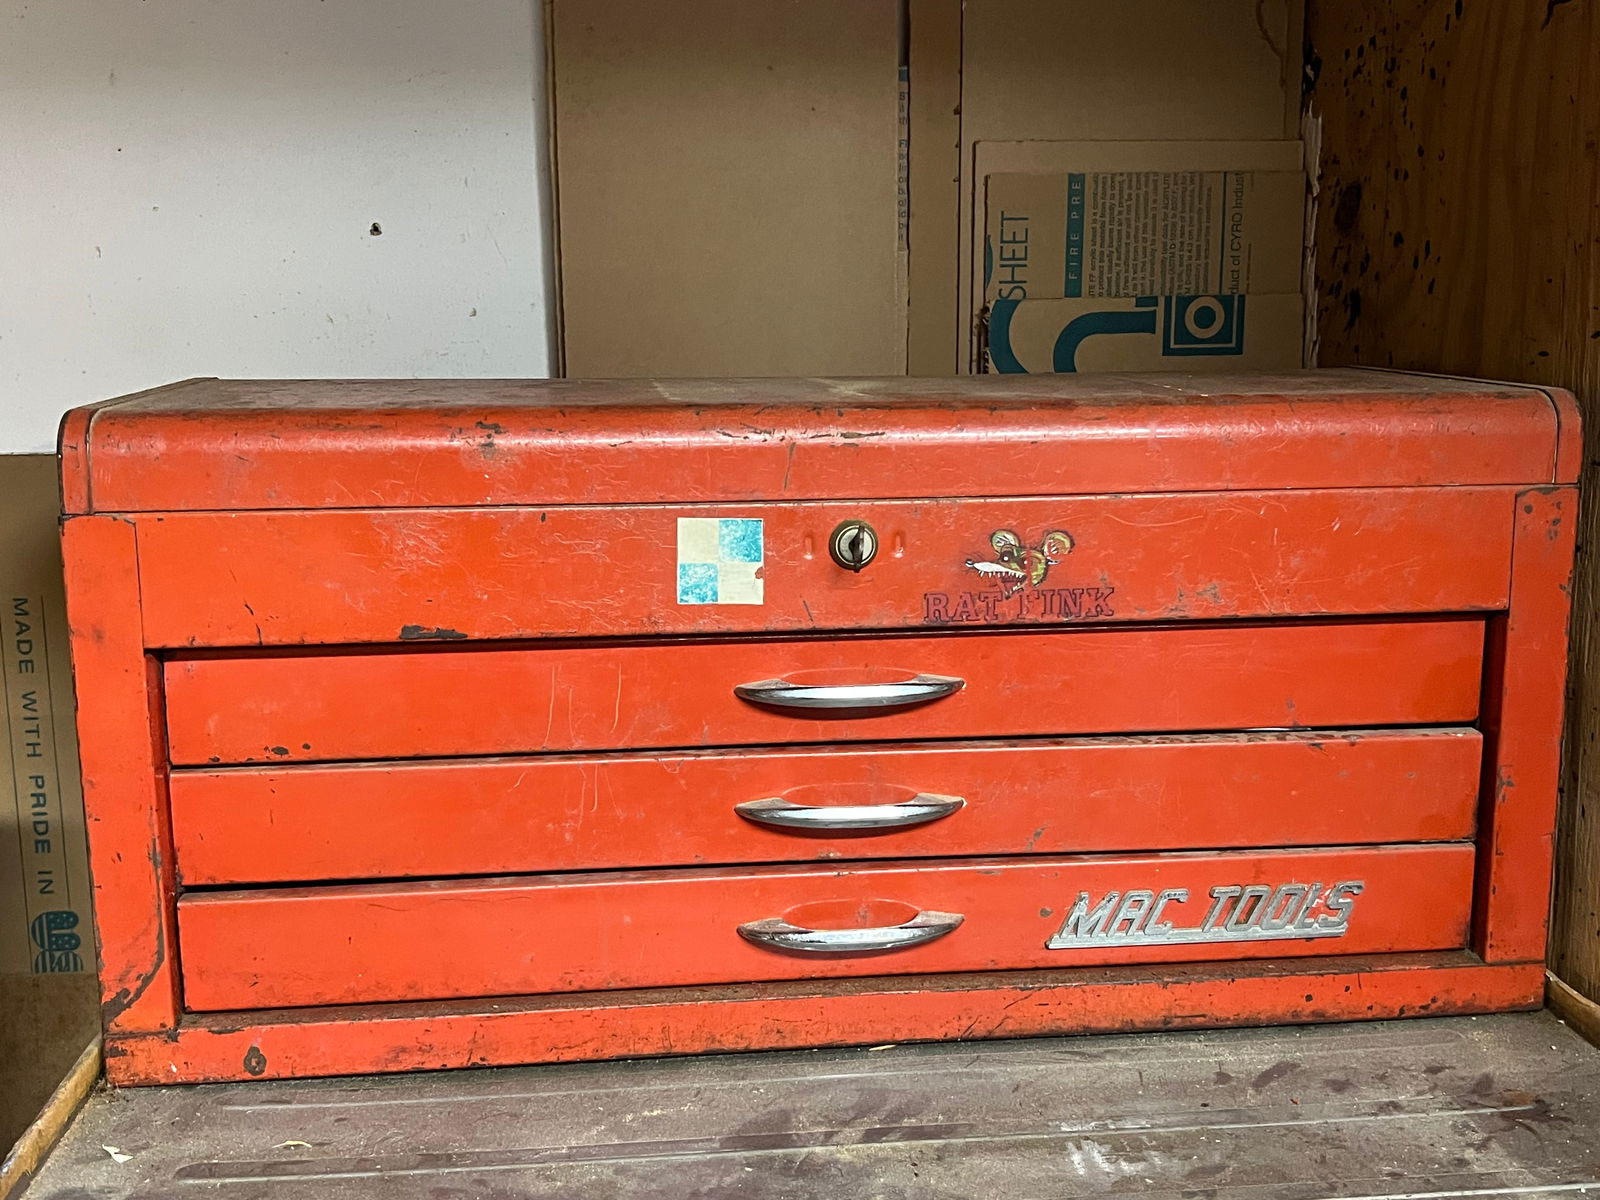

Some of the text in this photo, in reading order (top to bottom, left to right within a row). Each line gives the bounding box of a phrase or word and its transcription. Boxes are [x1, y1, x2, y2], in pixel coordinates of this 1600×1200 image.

[998, 211, 1028, 300] SHEET
[1069, 183, 1081, 279] FIRE PRE
[1230, 255, 1240, 265] of
[1231, 213, 1242, 251] CYRO
[1228, 269, 1240, 294] duct
[924, 587, 1115, 623] RAT FINK
[12, 597, 35, 674] MADE
[21, 691, 44, 758] WITH
[28, 775, 52, 855] PRIDE
[37, 870, 55, 895] IN
[1059, 881, 1365, 940] MAC TOOLS
